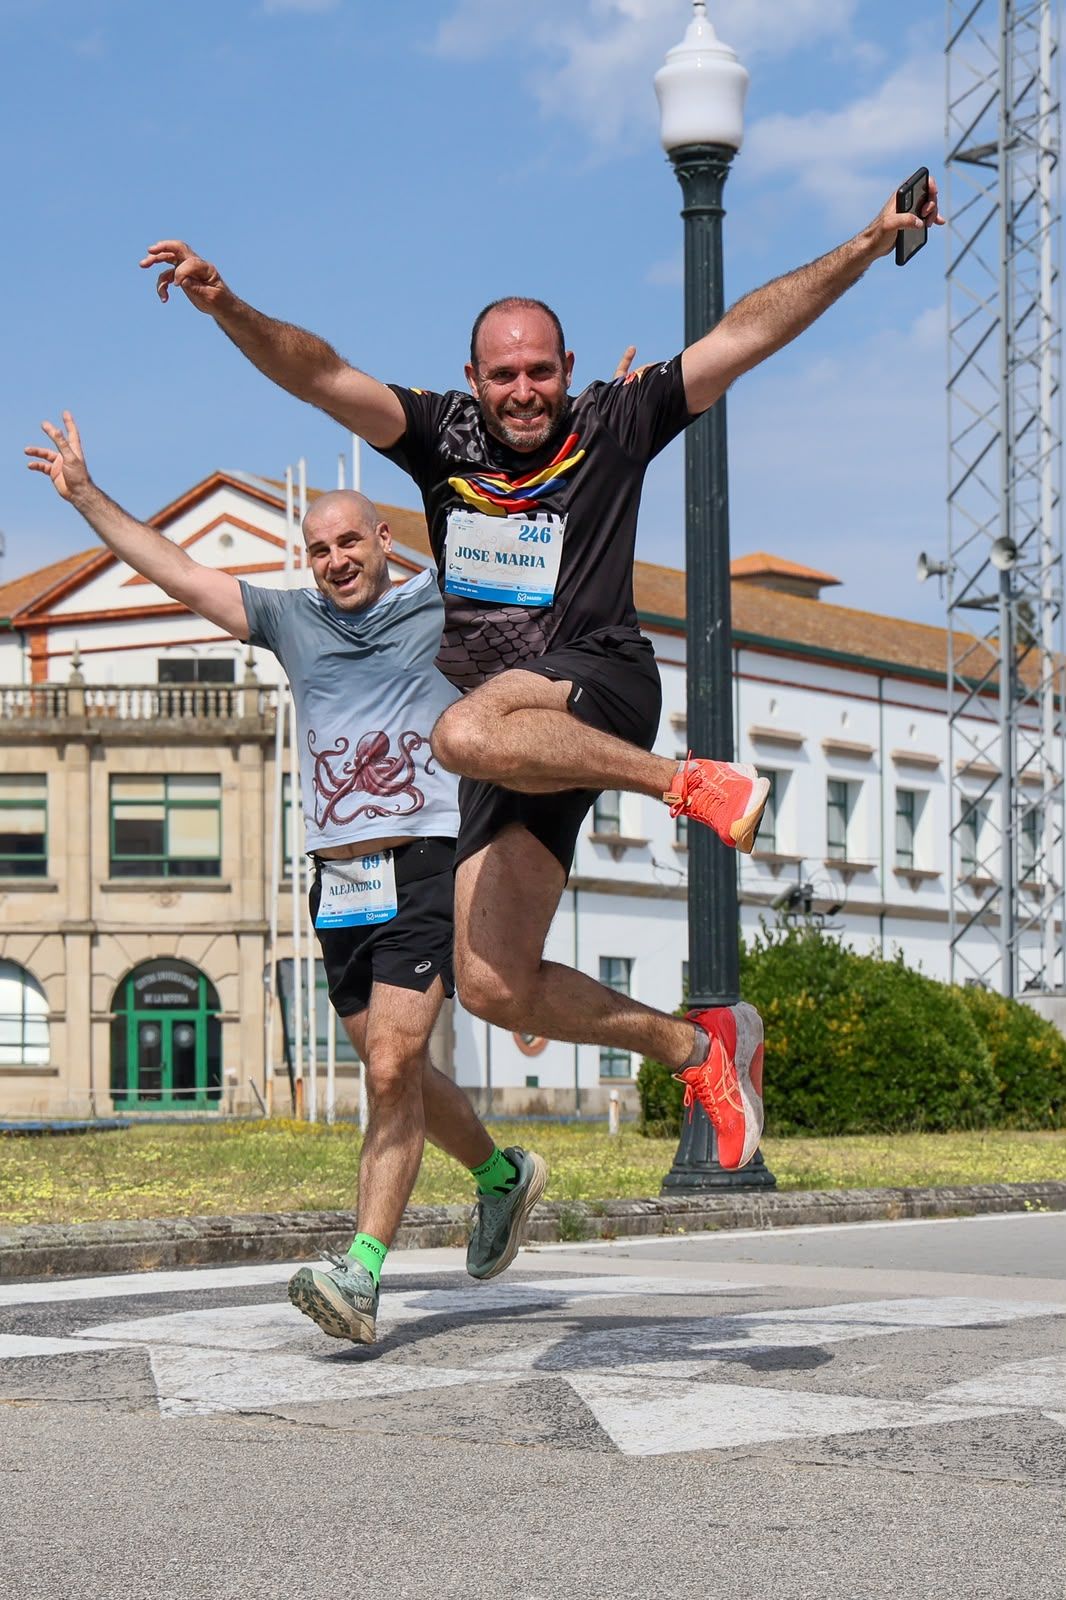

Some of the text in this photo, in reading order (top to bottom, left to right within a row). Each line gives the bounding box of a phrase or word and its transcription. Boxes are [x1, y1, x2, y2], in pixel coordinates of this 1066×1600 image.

[518, 525, 551, 544] 246
[455, 546, 546, 568] JOSE MARIA
[362, 854, 380, 870] 69
[329, 879, 381, 896] ALEJANDRO
